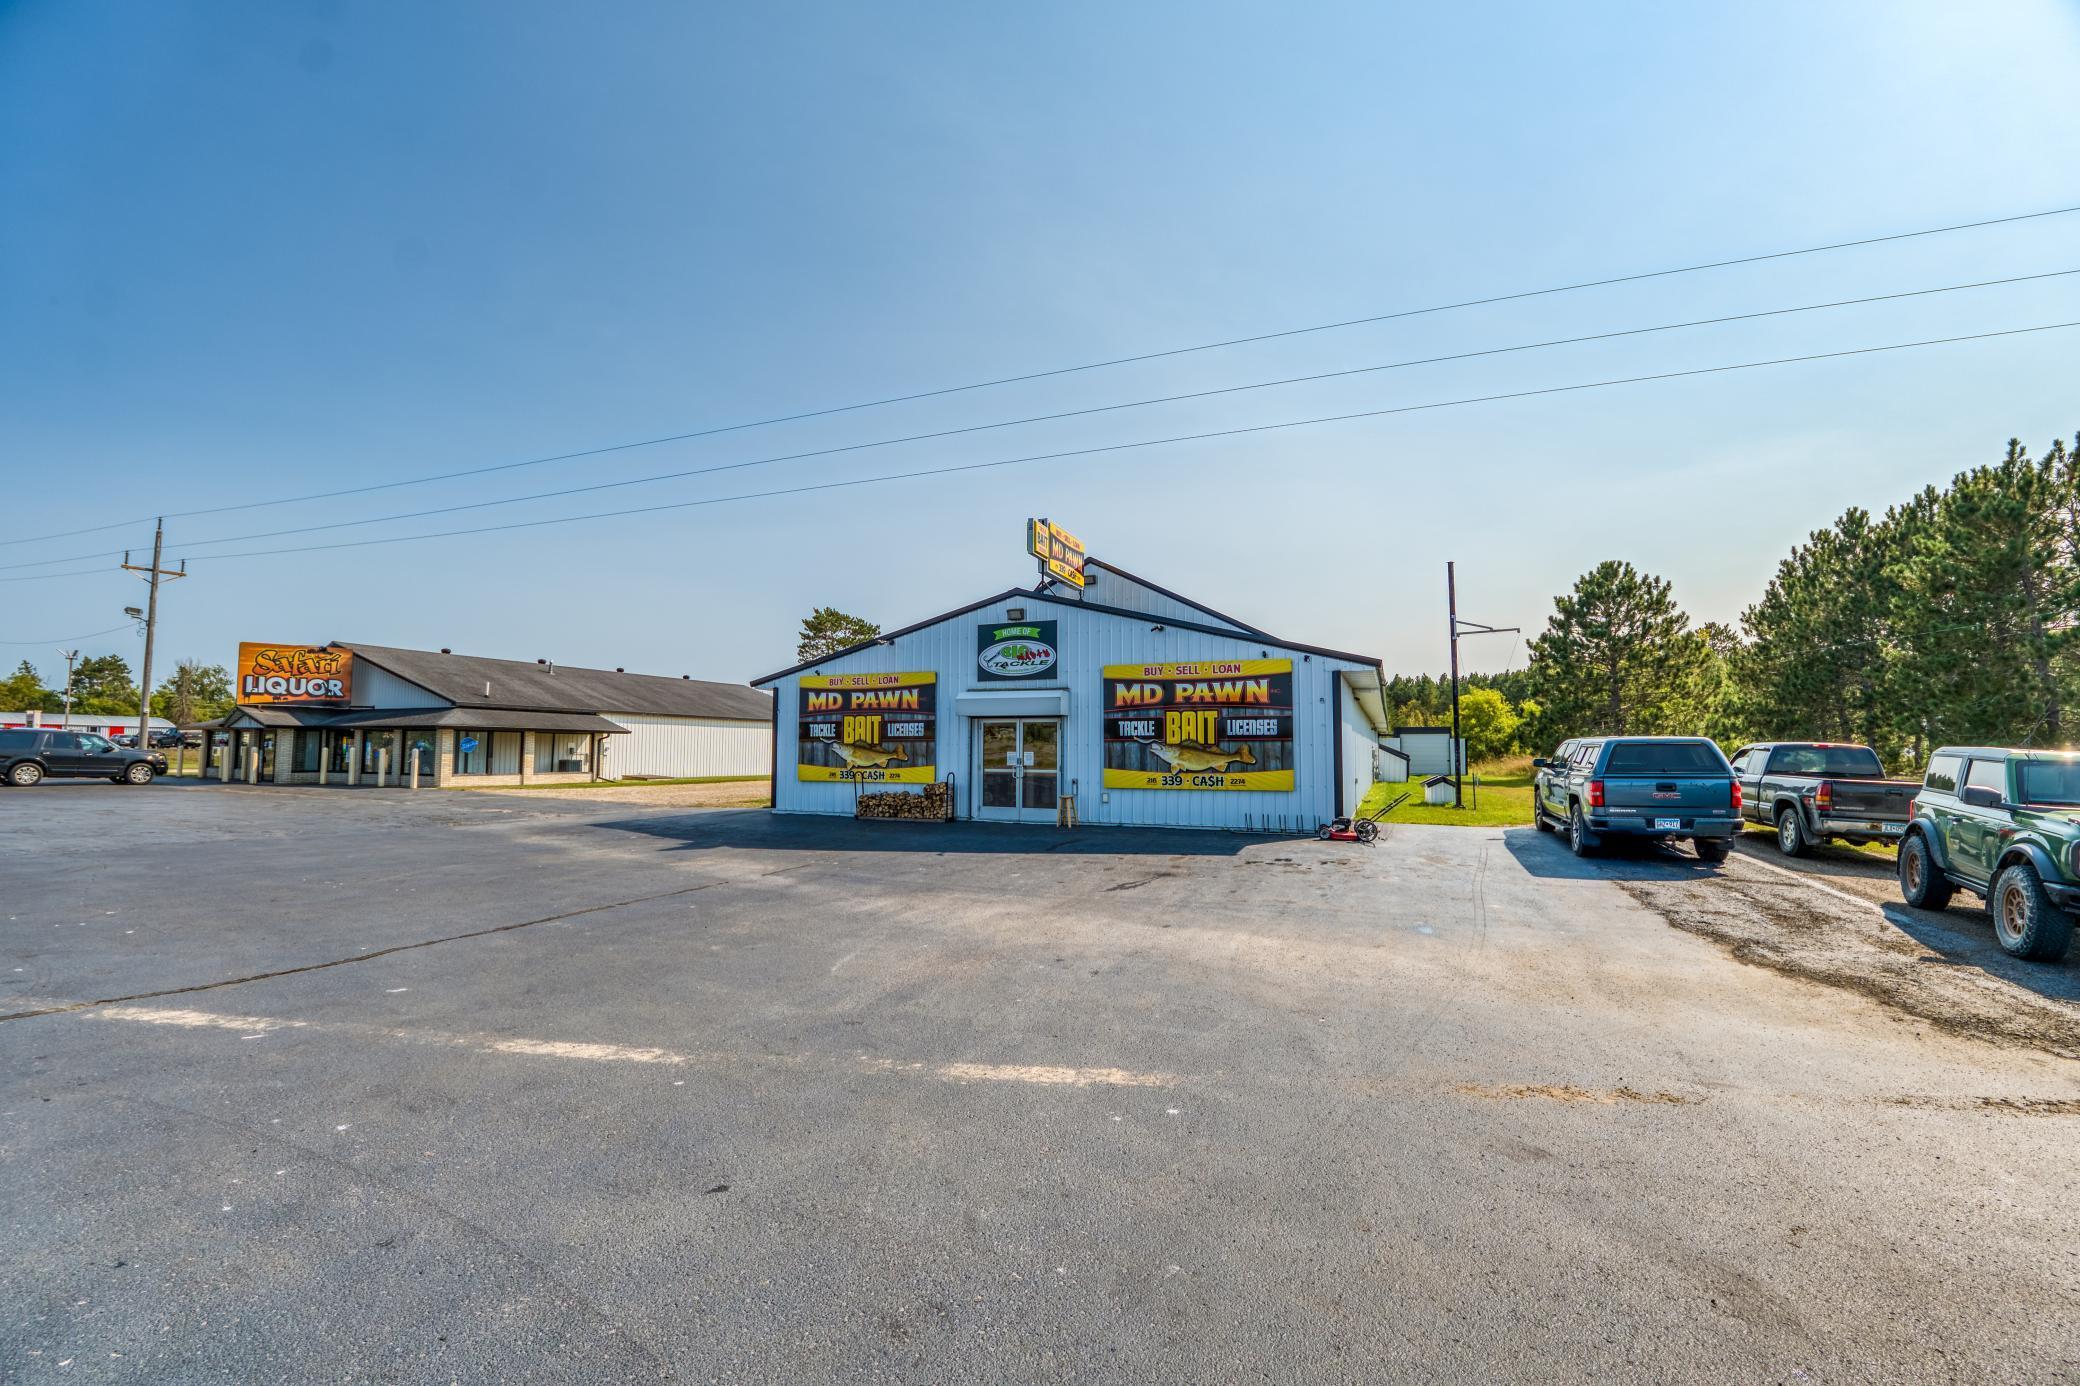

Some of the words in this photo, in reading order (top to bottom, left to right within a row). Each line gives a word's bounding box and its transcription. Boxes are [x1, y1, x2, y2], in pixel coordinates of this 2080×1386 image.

[1052, 538, 1064, 559] MD
[1065, 548, 1083, 573] PAWN
[1002, 628, 1021, 637] HOME
[252, 649, 341, 675] Safari
[994, 660, 1049, 668] TACKLE
[1144, 667, 1164, 676] BUY
[1176, 665, 1200, 675] SELL
[1212, 664, 1241, 674] LOAN
[244, 675, 344, 697] LIQUOR
[829, 678, 844, 686] BUY
[852, 677, 869, 686] SELL
[878, 676, 899, 685] LOAN
[808, 692, 843, 711] MD
[851, 688, 920, 710] PAWN
[1115, 683, 1164, 706] MD
[1175, 680, 1269, 704] PAWN
[809, 723, 836, 737] TACKLE
[843, 715, 882, 744] BAIT
[887, 722, 925, 737] LICENSES
[1118, 720, 1155, 737] TACKLE
[1165, 710, 1219, 745] BAIT
[1227, 719, 1278, 736] LICENSES
[839, 771, 854, 779] 339
[862, 770, 885, 780] CA$H
[1161, 776, 1183, 786] 339
[1192, 775, 1224, 787] CA$H
